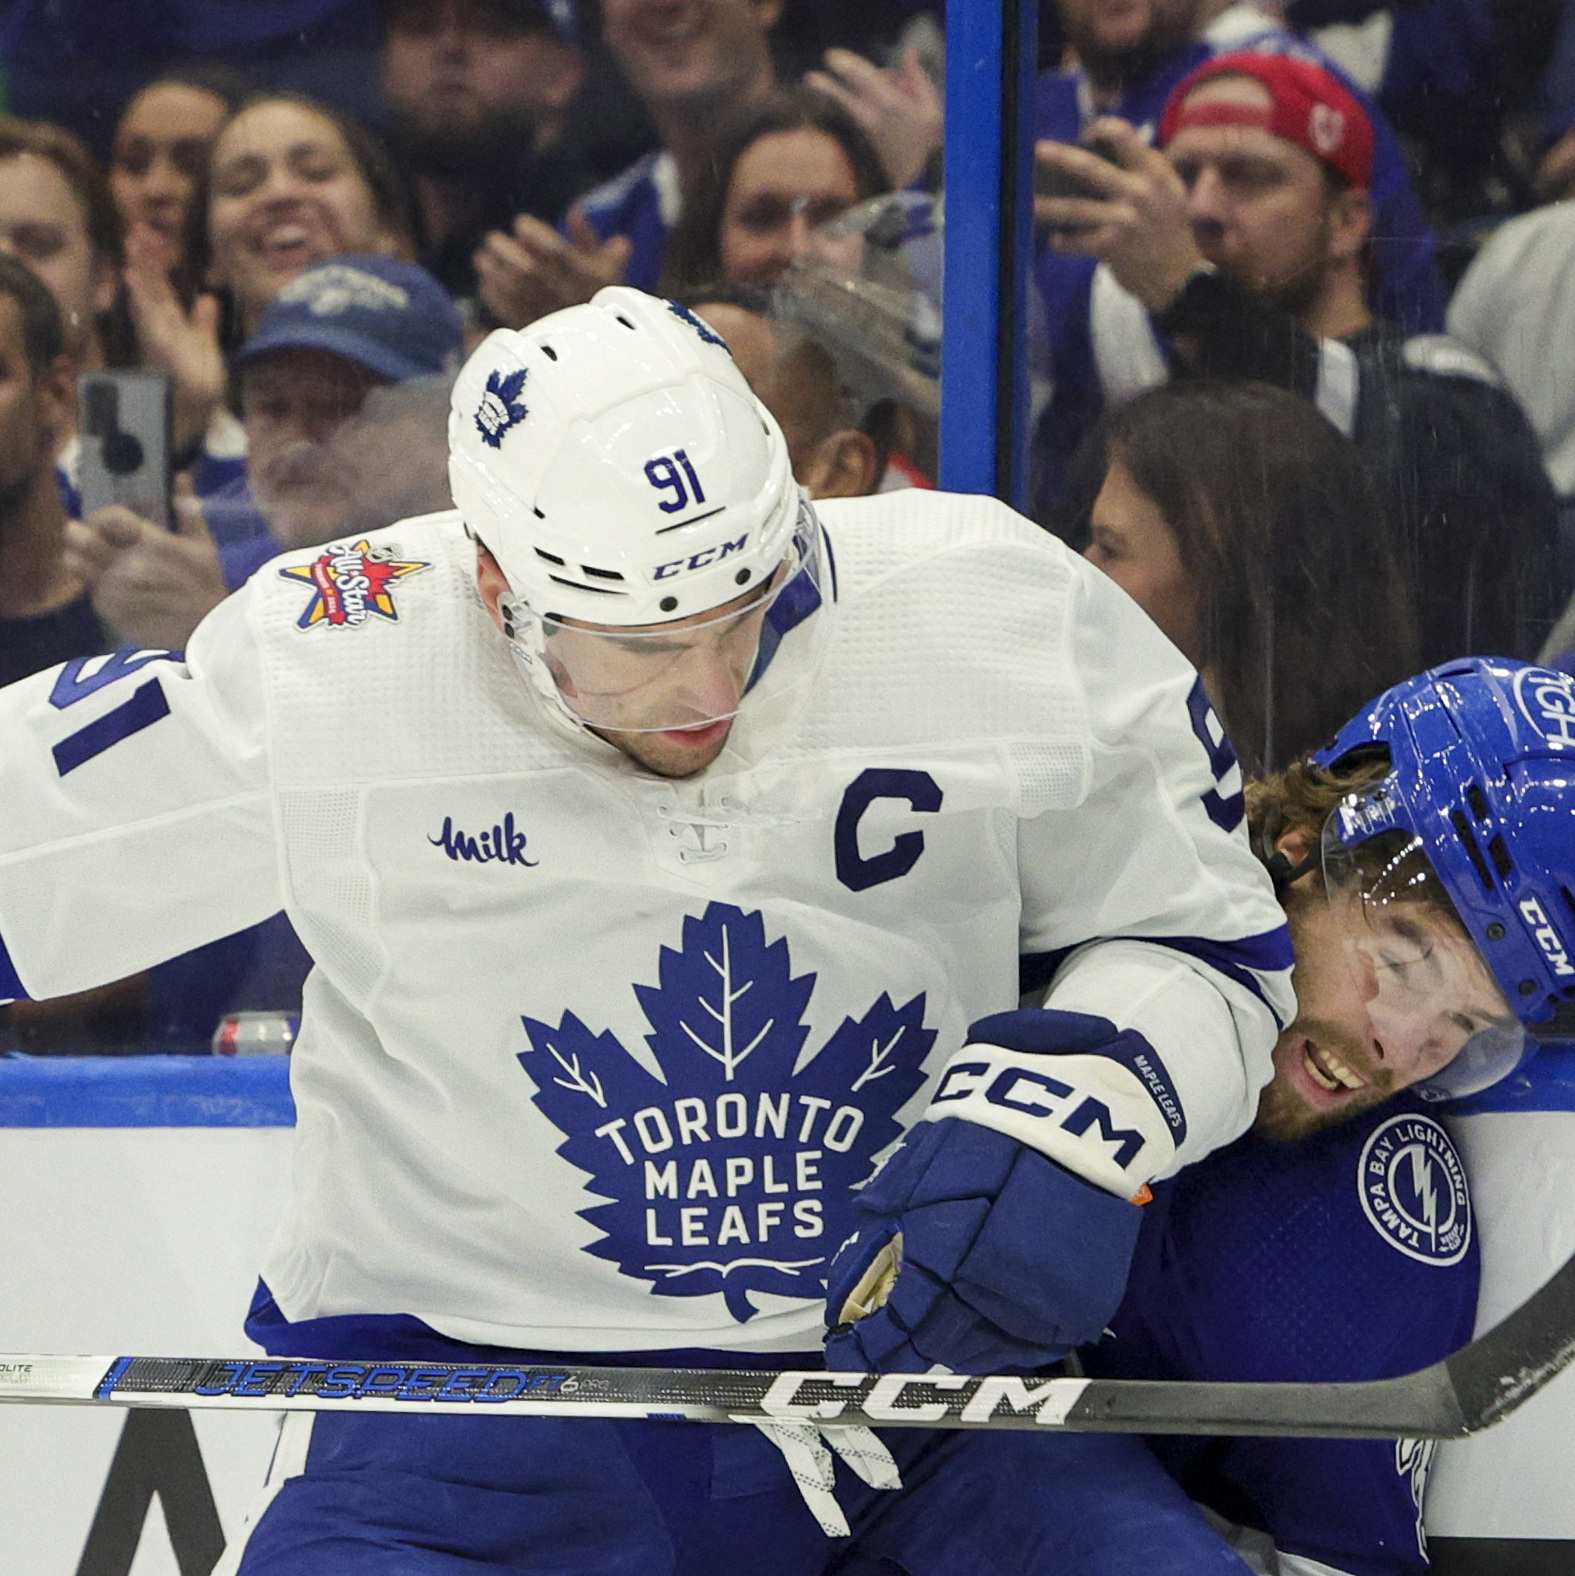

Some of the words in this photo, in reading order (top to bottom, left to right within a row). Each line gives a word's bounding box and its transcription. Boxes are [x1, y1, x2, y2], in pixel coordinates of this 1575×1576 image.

[644, 449, 706, 514] 91
[652, 533, 749, 581] CCM
[427, 811, 540, 867] milk
[835, 767, 942, 892] C
[1519, 896, 1575, 977] CCM
[930, 1062, 1146, 1172] CCM
[1133, 1054, 1165, 1095] MAPLE
[1158, 1093, 1182, 1128] LEAFS
[594, 1091, 865, 1166] TORONTO
[1369, 1137, 1394, 1177] BAY
[643, 1149, 824, 1201] MAPLE
[1395, 1123, 1466, 1205] LIGHTNING
[645, 1198, 825, 1247] LEAFS
[1370, 1183, 1420, 1248] TAMPA
[195, 1364, 528, 1403] JETSPEED
[759, 1371, 1093, 1425] CCM
